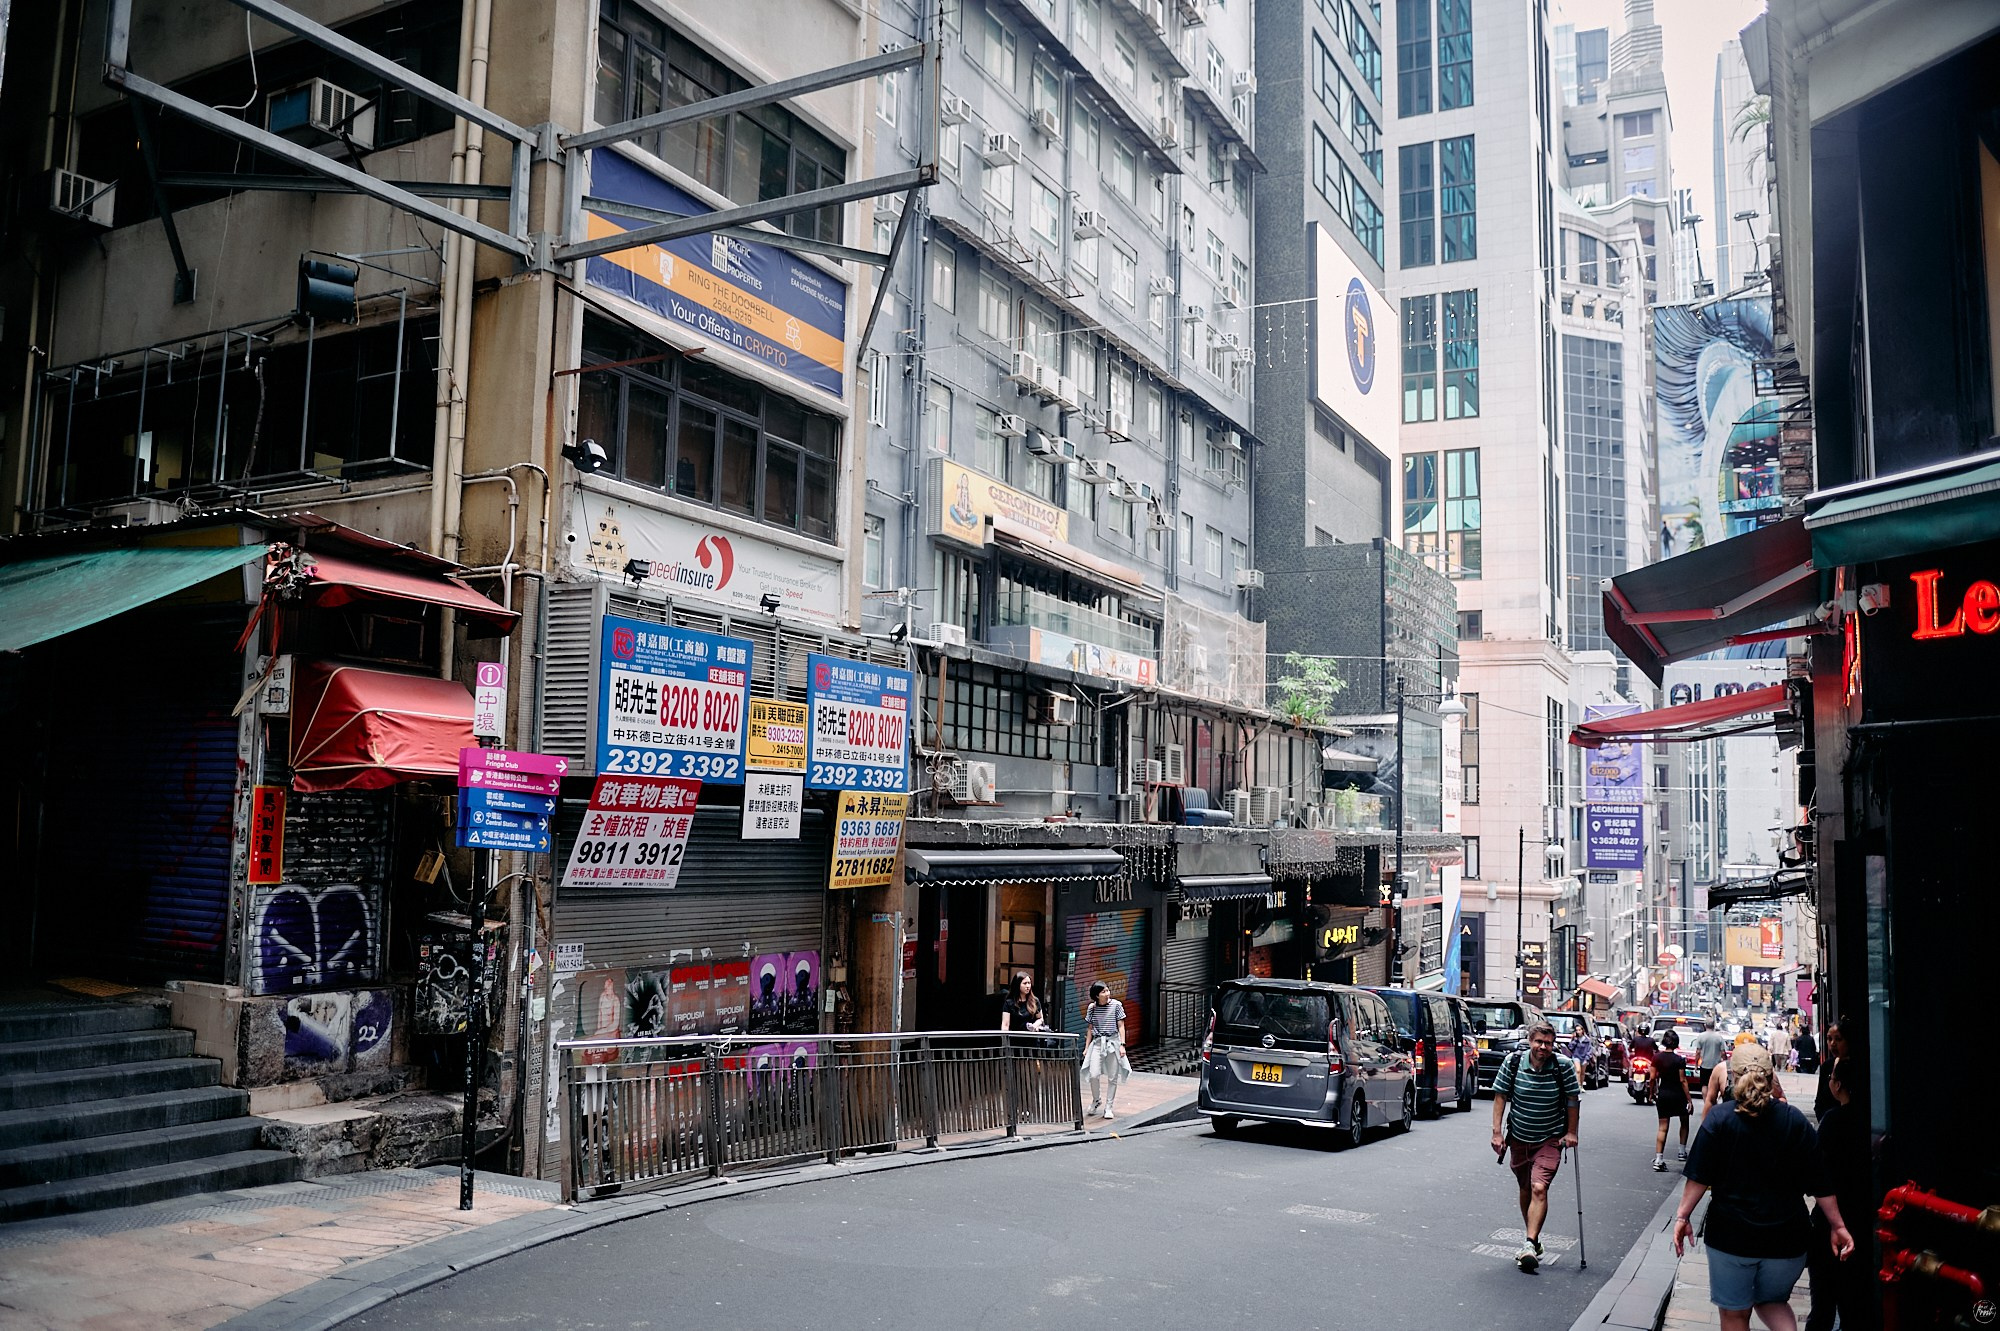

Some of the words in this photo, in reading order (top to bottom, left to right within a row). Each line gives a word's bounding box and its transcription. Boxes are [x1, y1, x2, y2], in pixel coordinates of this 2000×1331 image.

[728, 238, 752, 258] PACIFIC
[728, 265, 762, 290] PROPERTIES
[688, 270, 710, 290] RING
[712, 282, 730, 301] THE
[731, 290, 775, 323] DOORBELL
[671, 299, 696, 325] Your
[698, 313, 730, 341] Offers
[732, 329, 743, 346] in
[745, 336, 788, 367] CRYPTO
[648, 560, 714, 590] peedinsure
[738, 563, 751, 575] Your
[752, 567, 772, 580] Trusted
[773, 572, 799, 587] Insurance
[800, 579, 817, 591] Broker
[760, 581, 770, 590] Get
[785, 588, 804, 600] Speed
[476, 691, 498, 731] 中環
[615, 676, 658, 715] 胡先生
[660, 683, 699, 730] 8208
[703, 690, 740, 734] 8020
[767, 726, 804, 744] 9303-2252
[817, 704, 847, 736] 胡先生
[848, 709, 875, 748] 8208
[877, 713, 903, 750] 8020
[485, 760, 504, 769] Fringe
[505, 761, 519, 769] Club
[606, 749, 673, 775] 2392
[680, 754, 739, 779] 3392
[493, 780, 513, 788] Zoological
[810, 764, 858, 786] 2392
[861, 768, 904, 789] 3392
[485, 799, 511, 808] Wyndham
[511, 801, 526, 809] Street
[598, 781, 680, 809] 敬華物業
[882, 796, 902, 806] Mutual
[856, 795, 881, 816] 永昇
[881, 806, 905, 818] Property
[485, 819, 502, 827] Central
[841, 820, 871, 836] 9363
[874, 821, 901, 836] 6681
[481, 838, 498, 846] Central
[518, 841, 536, 849] Escalator
[1599, 837, 1619, 845] 3628
[1620, 837, 1640, 846] 4027
[577, 840, 630, 865] 9811
[634, 842, 683, 866] 3912
[835, 857, 895, 877] 27811682
[671, 965, 710, 984] OPEN
[712, 961, 750, 979] OPEN
[674, 1010, 705, 1022] TRIPOLISM
[715, 1005, 745, 1016] TRIPOLISM
